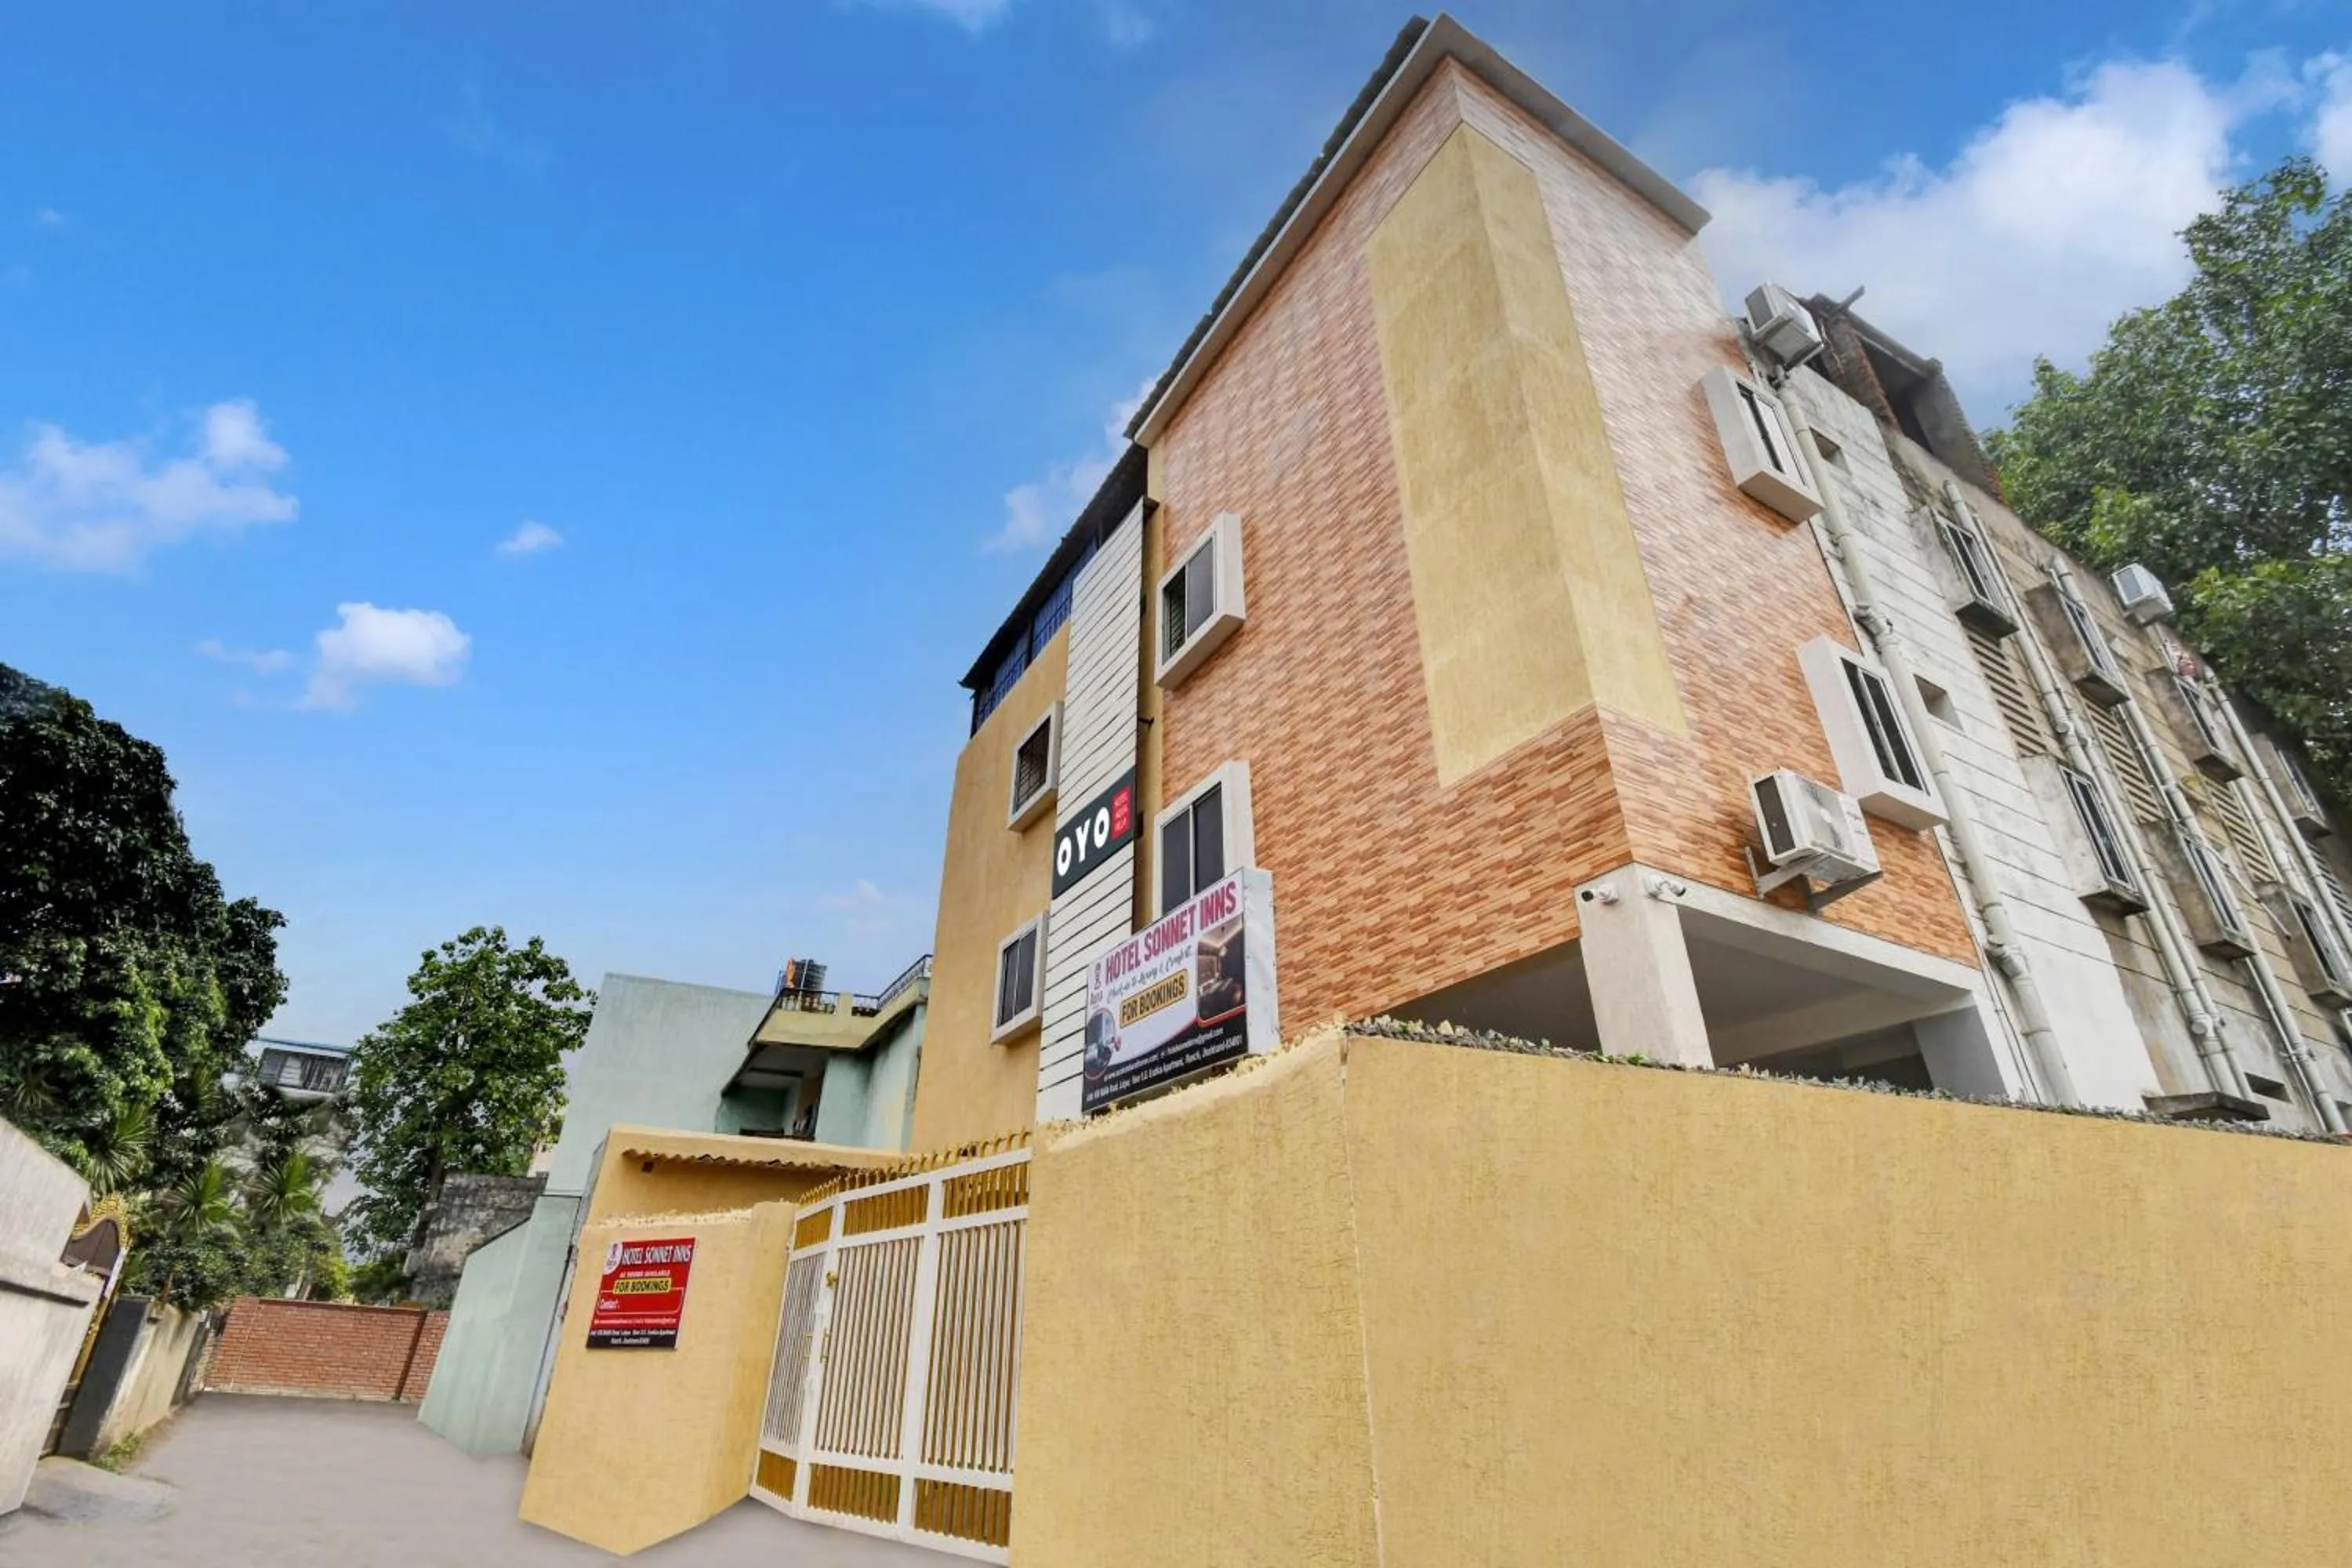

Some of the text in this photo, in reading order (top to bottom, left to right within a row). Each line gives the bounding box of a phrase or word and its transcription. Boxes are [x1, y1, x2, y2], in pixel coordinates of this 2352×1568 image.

[1057, 807, 1110, 877] OYO
[1105, 880, 1236, 985] HOTEL SONNET INNS
[1123, 1000, 1138, 1023] FOR
[1139, 975, 1185, 1015] BOOKINGS
[622, 1247, 643, 1265] HOTEL
[644, 1245, 673, 1264] SONNET
[673, 1244, 691, 1262] INNS
[615, 1279, 670, 1293] FOR BOOKINGS
